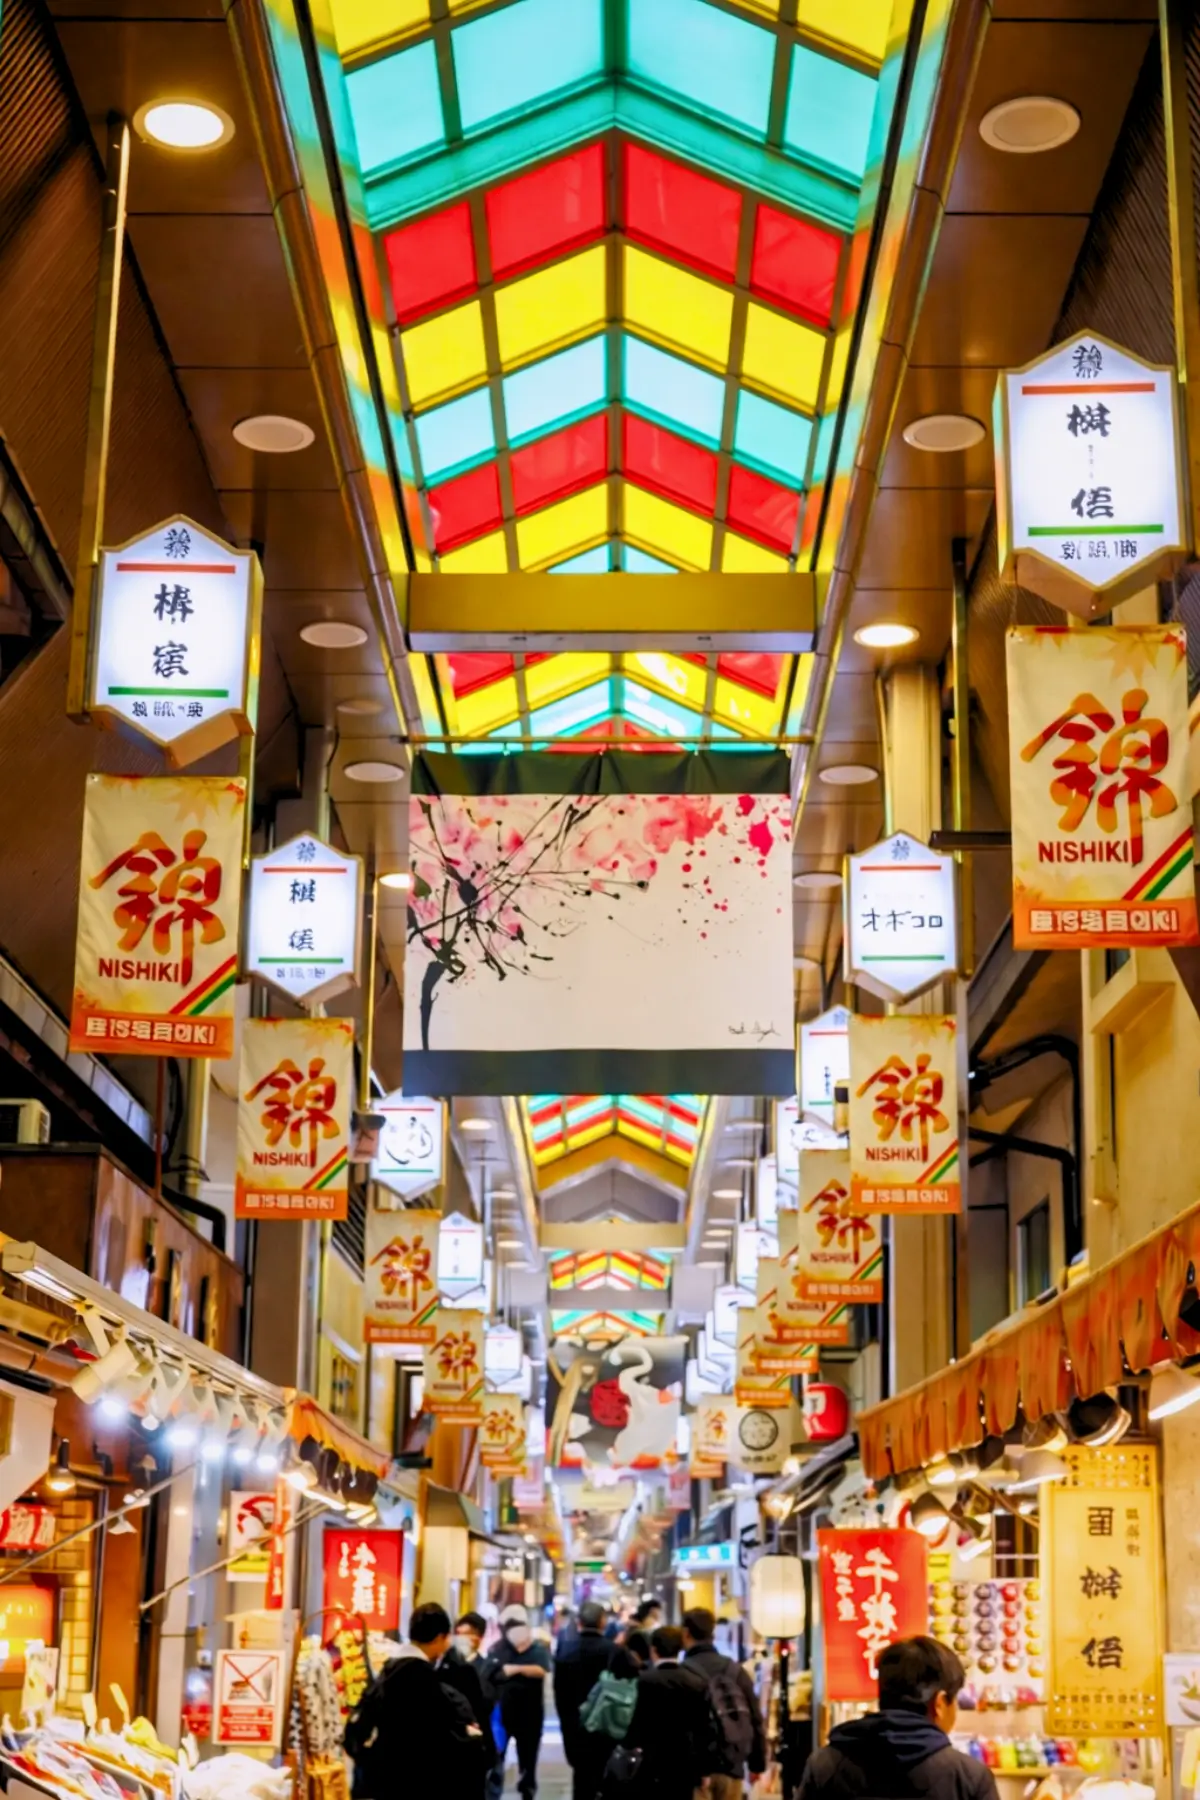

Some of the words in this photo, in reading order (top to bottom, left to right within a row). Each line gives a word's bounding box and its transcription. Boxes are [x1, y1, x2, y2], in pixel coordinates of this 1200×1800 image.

[1020, 688, 1178, 868] 錦
[1038, 840, 1131, 863] NISHIKI
[88, 829, 226, 988] 錦
[98, 957, 180, 984] NISHIKI
[244, 1057, 341, 1168] 錦
[856, 1053, 950, 1163] 錦
[252, 1151, 311, 1168] NISHIKI
[865, 1146, 921, 1162] NISHIKI
[370, 1235, 434, 1311] 錦
